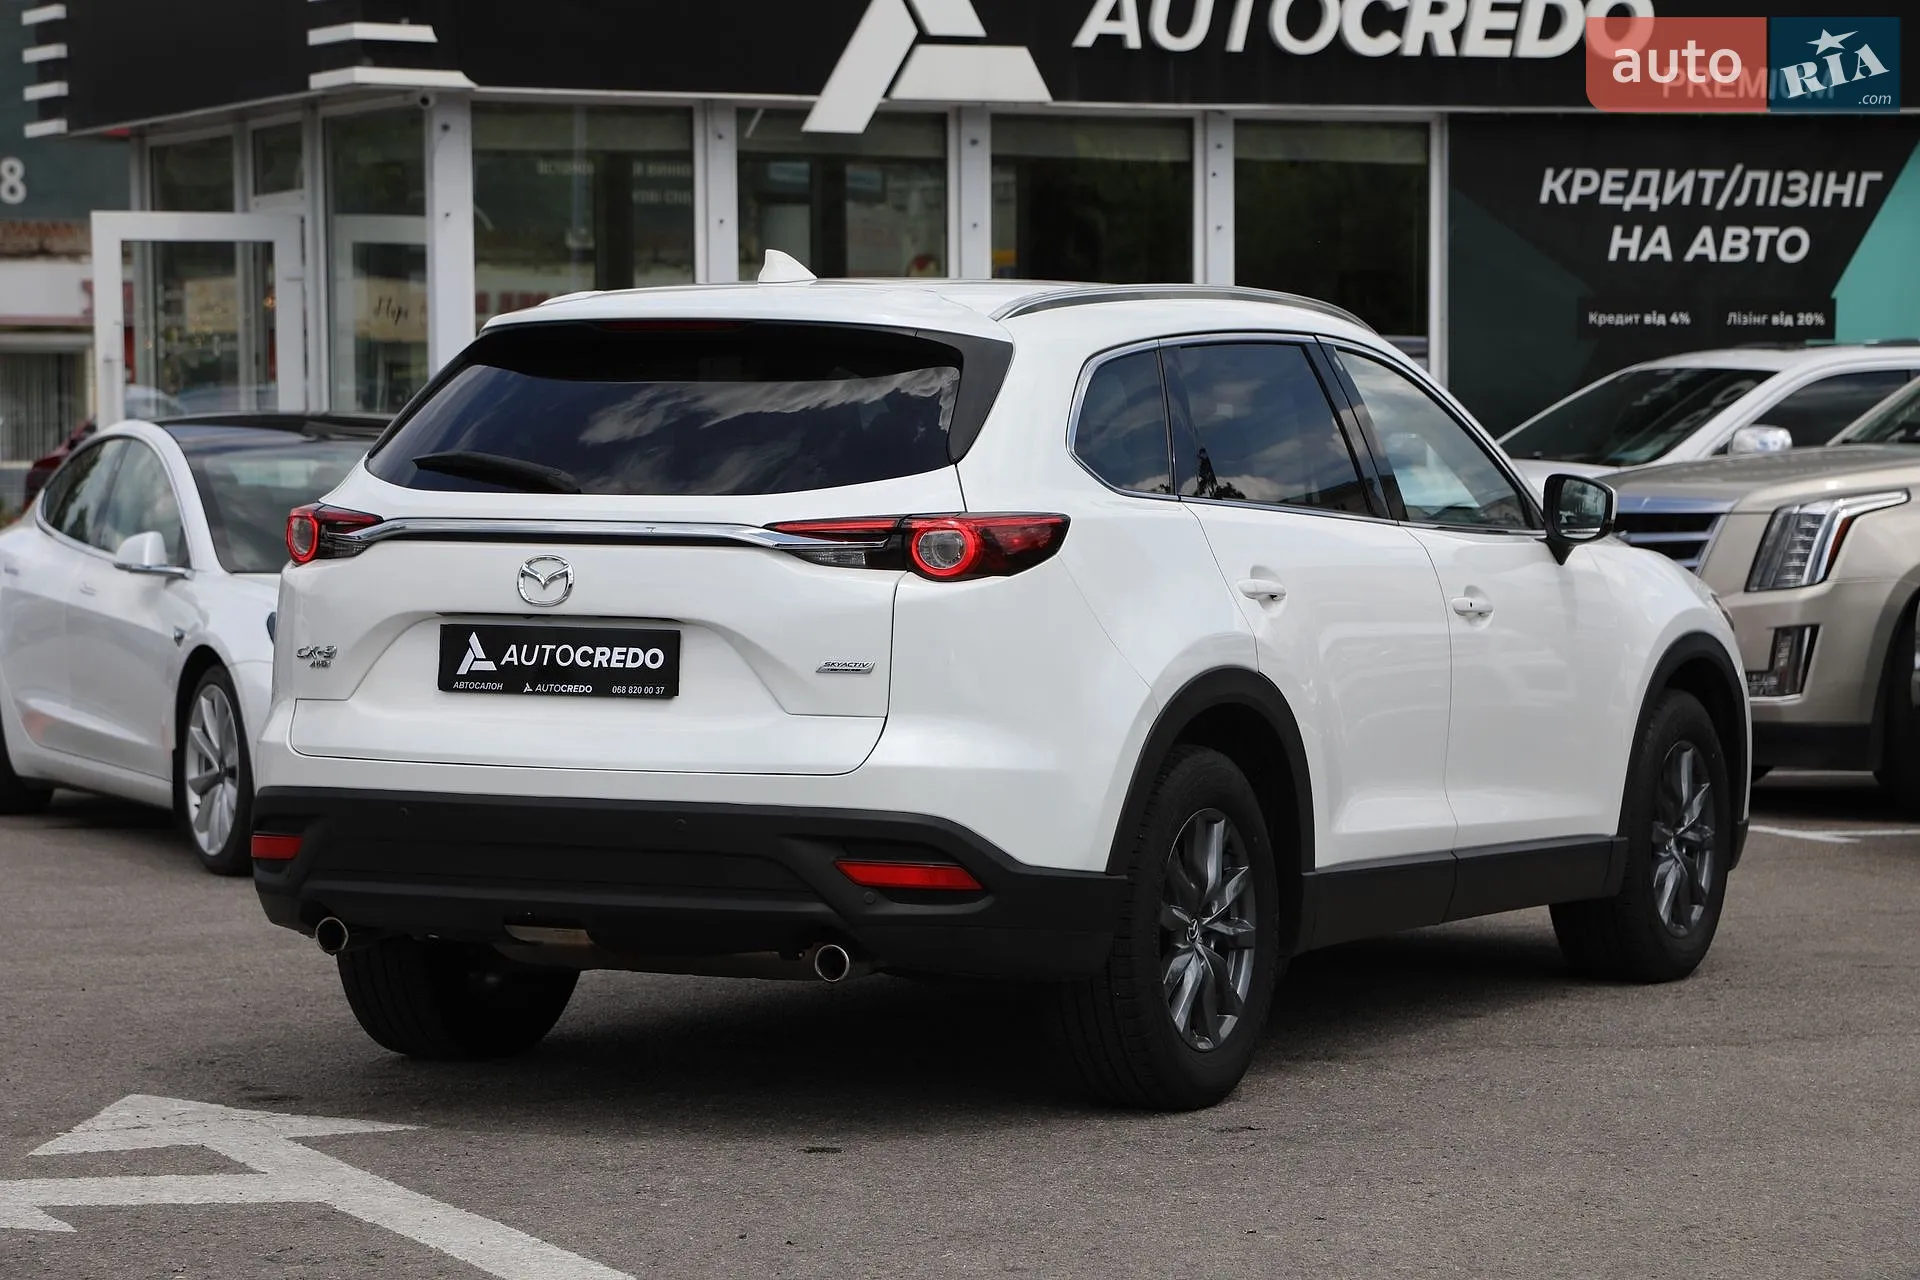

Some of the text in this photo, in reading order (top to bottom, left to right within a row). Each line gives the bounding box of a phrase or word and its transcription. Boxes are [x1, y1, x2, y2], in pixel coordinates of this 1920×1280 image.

[1539, 165, 1883, 211] КРЕДИТ/ЛІЗІНГ
[1607, 226, 1811, 265] НА АВТО
[1588, 311, 1692, 327] Кредит від 4%
[1726, 311, 1826, 327] Лізінг від 20%
[500, 644, 665, 669] AUTOCREDO
[453, 681, 504, 691] АВТОСАЛОН
[535, 683, 593, 694] AUTOCREDO
[612, 685, 665, 695] 068 820 00 37
